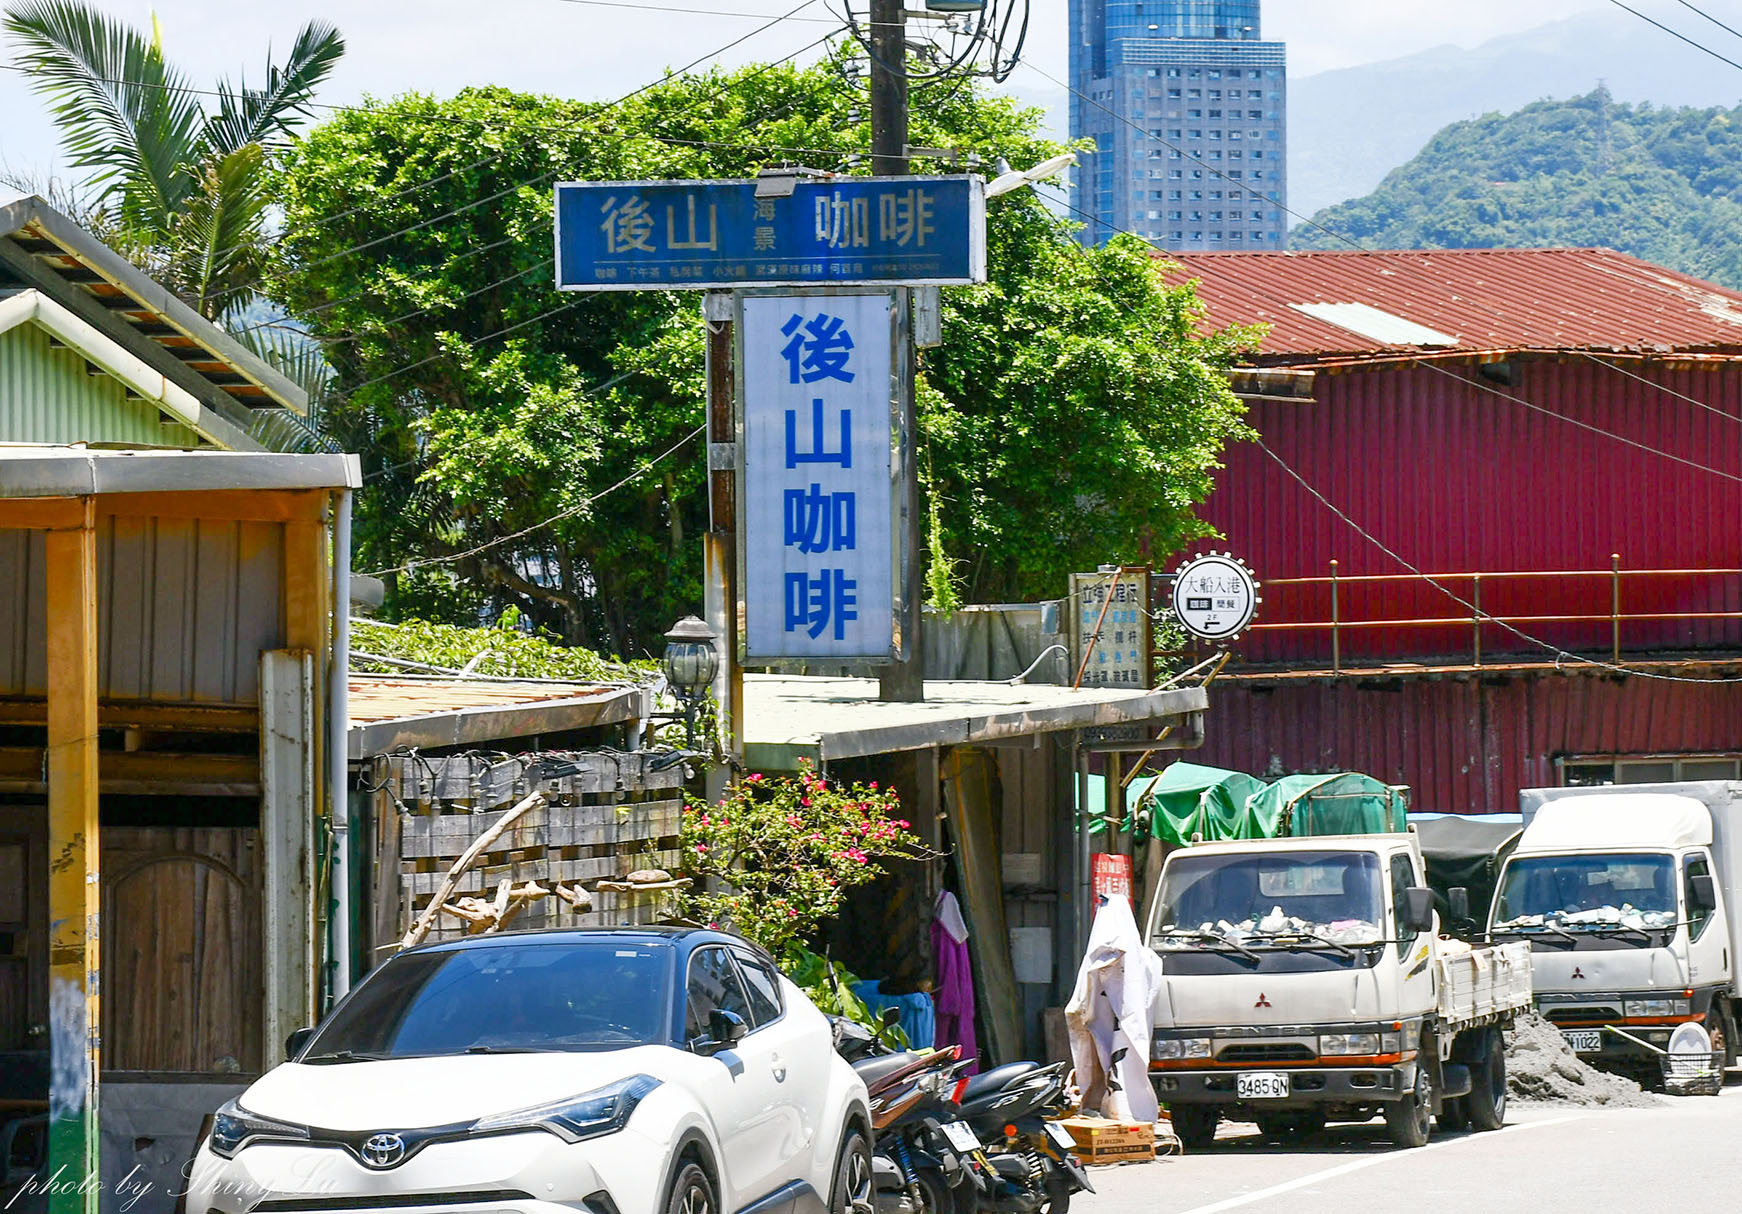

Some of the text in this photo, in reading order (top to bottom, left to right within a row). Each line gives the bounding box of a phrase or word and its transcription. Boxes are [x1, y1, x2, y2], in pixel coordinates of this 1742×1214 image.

[600, 189, 935, 254] 後山 咖啡
[753, 199, 777, 252] 海景
[780, 312, 858, 641] 後山咖啡
[1184, 576, 1241, 594] 大船入港
